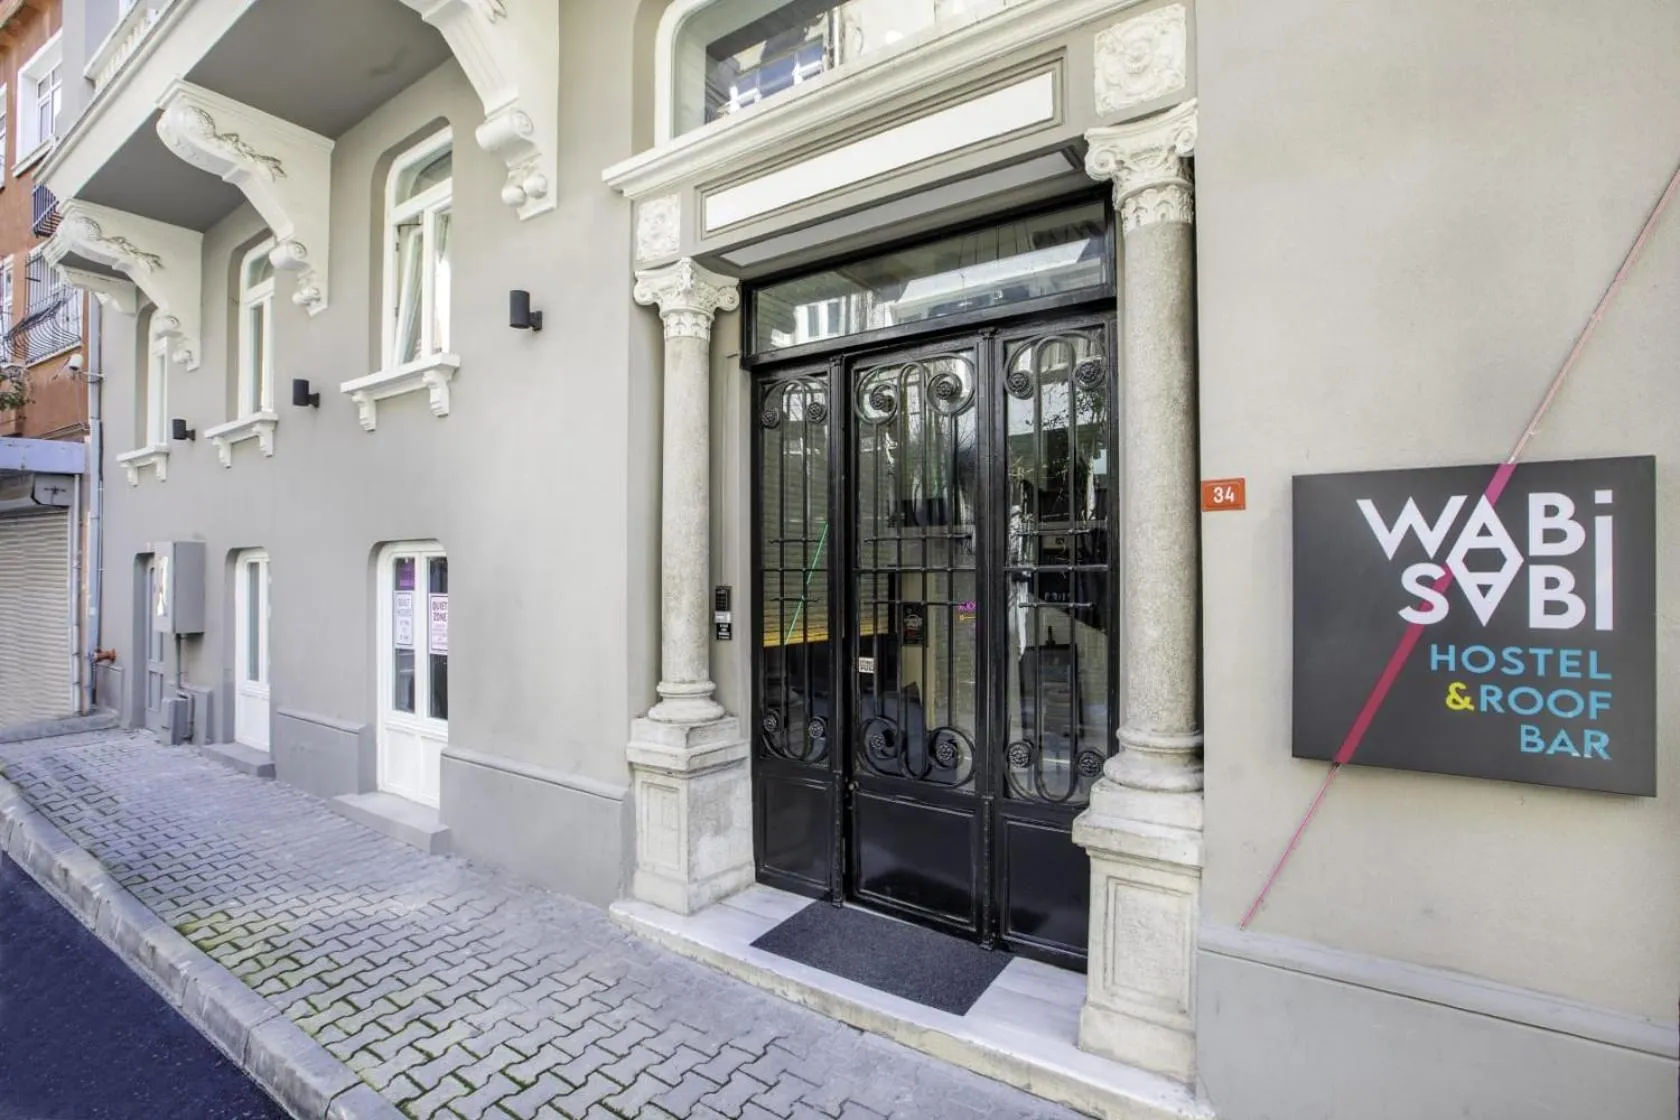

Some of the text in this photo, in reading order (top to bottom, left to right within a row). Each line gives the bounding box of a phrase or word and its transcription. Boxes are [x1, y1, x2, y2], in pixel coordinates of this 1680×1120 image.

[1213, 486, 1235, 504] 34
[1430, 644, 1612, 680] HOSTEL
[1520, 724, 1612, 760] BAR
